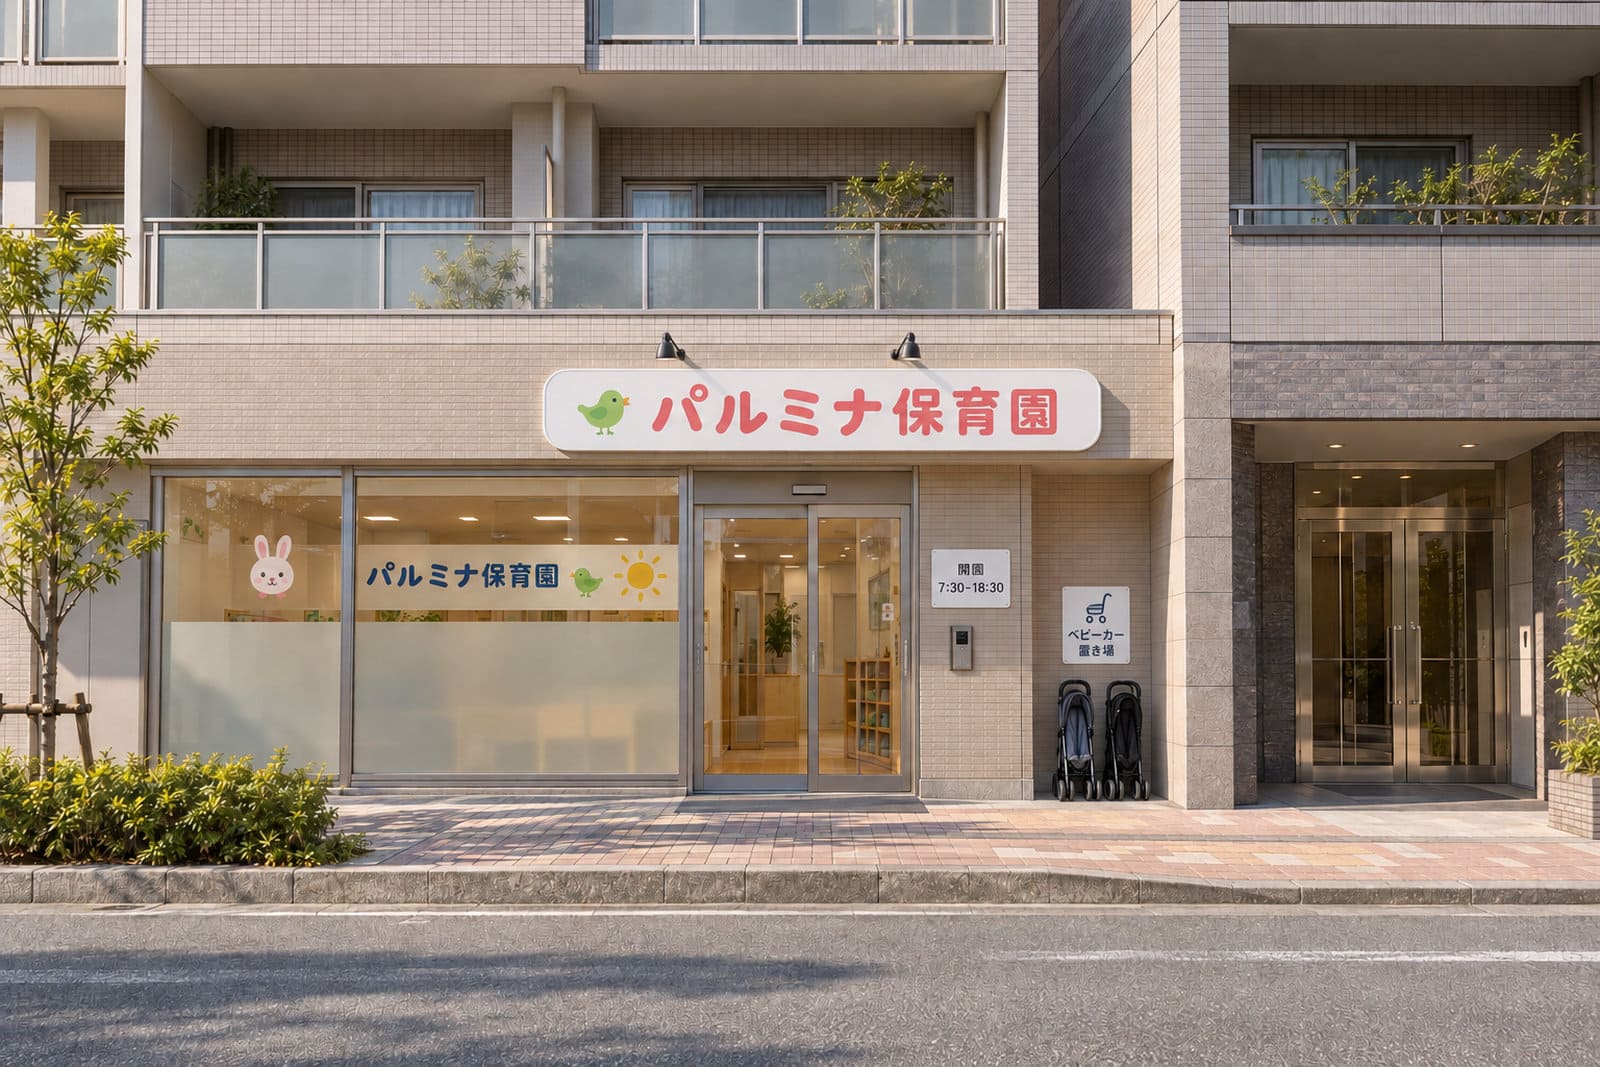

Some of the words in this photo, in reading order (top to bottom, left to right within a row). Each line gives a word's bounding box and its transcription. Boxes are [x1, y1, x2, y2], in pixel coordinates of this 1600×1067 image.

[651, 383, 1058, 436] パルミナ保育園
[366, 562, 559, 588] パルミナ保育園
[938, 582, 1004, 593] 7:30-18:30
